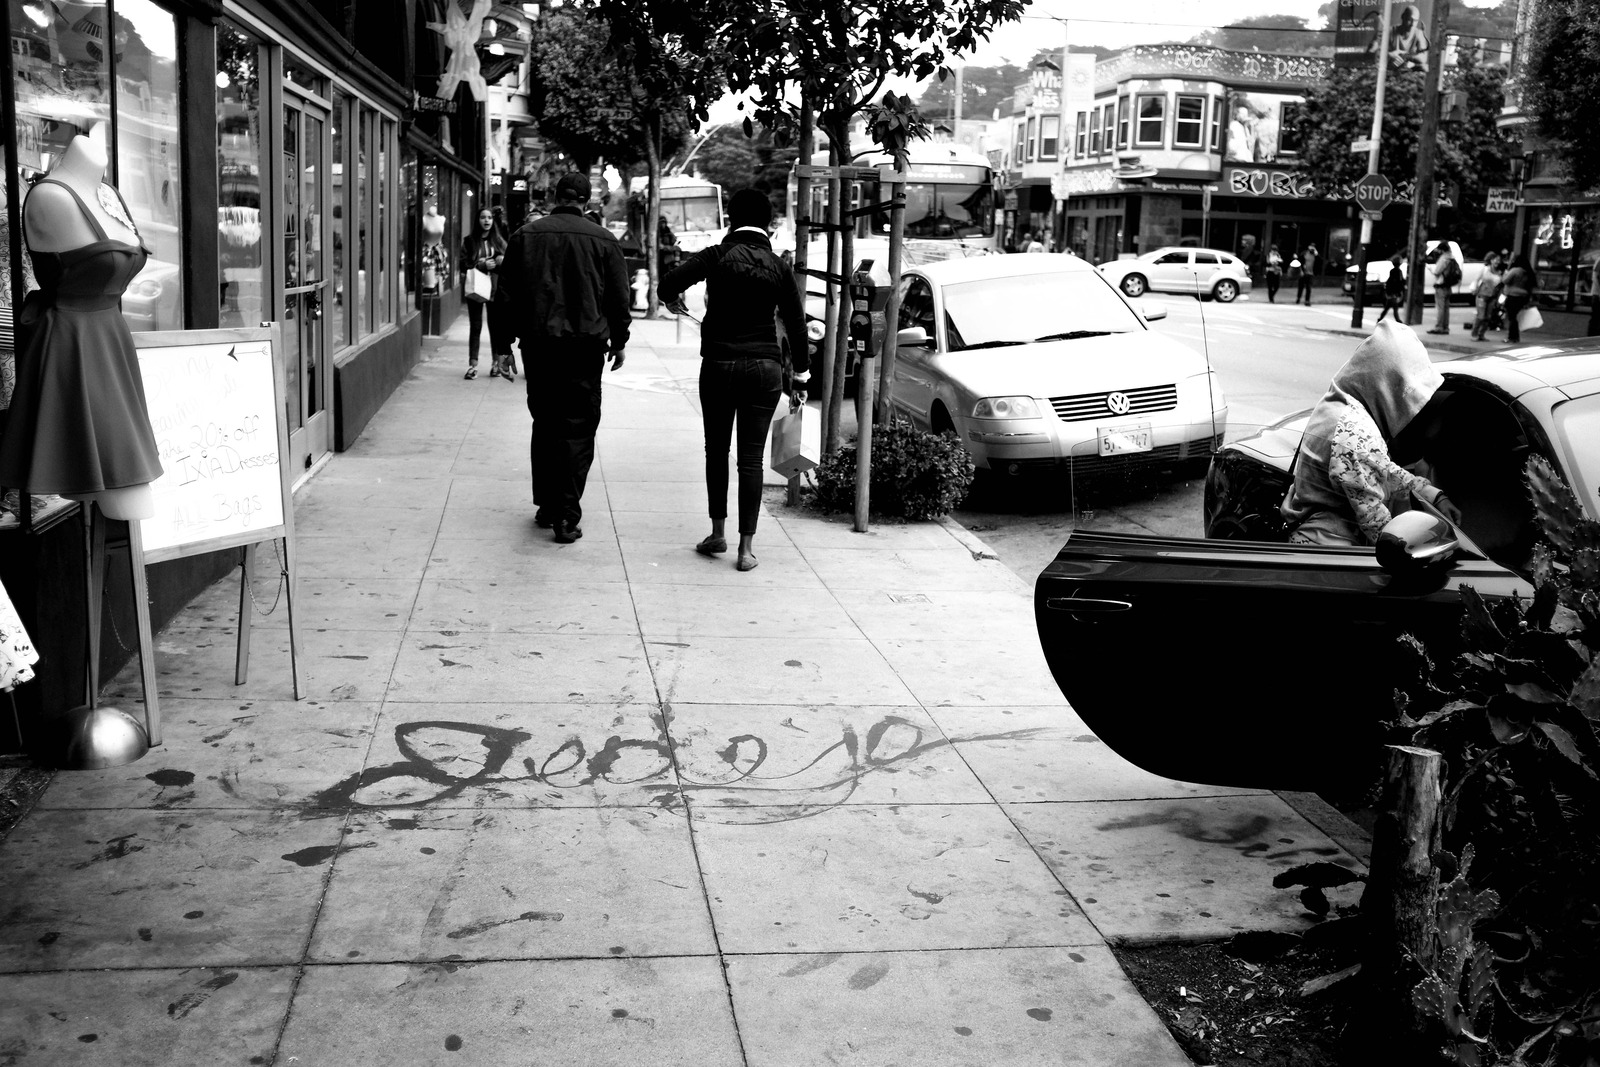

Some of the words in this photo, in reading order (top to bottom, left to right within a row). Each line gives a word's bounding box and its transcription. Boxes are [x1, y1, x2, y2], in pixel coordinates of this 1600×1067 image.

[1174, 50, 1213, 69] 1967
[1359, 184, 1390, 201] STOP
[1489, 201, 1514, 211] ATM
[189, 421, 229, 449] 20%
[234, 414, 260, 442] off
[212, 493, 263, 527] Bags
